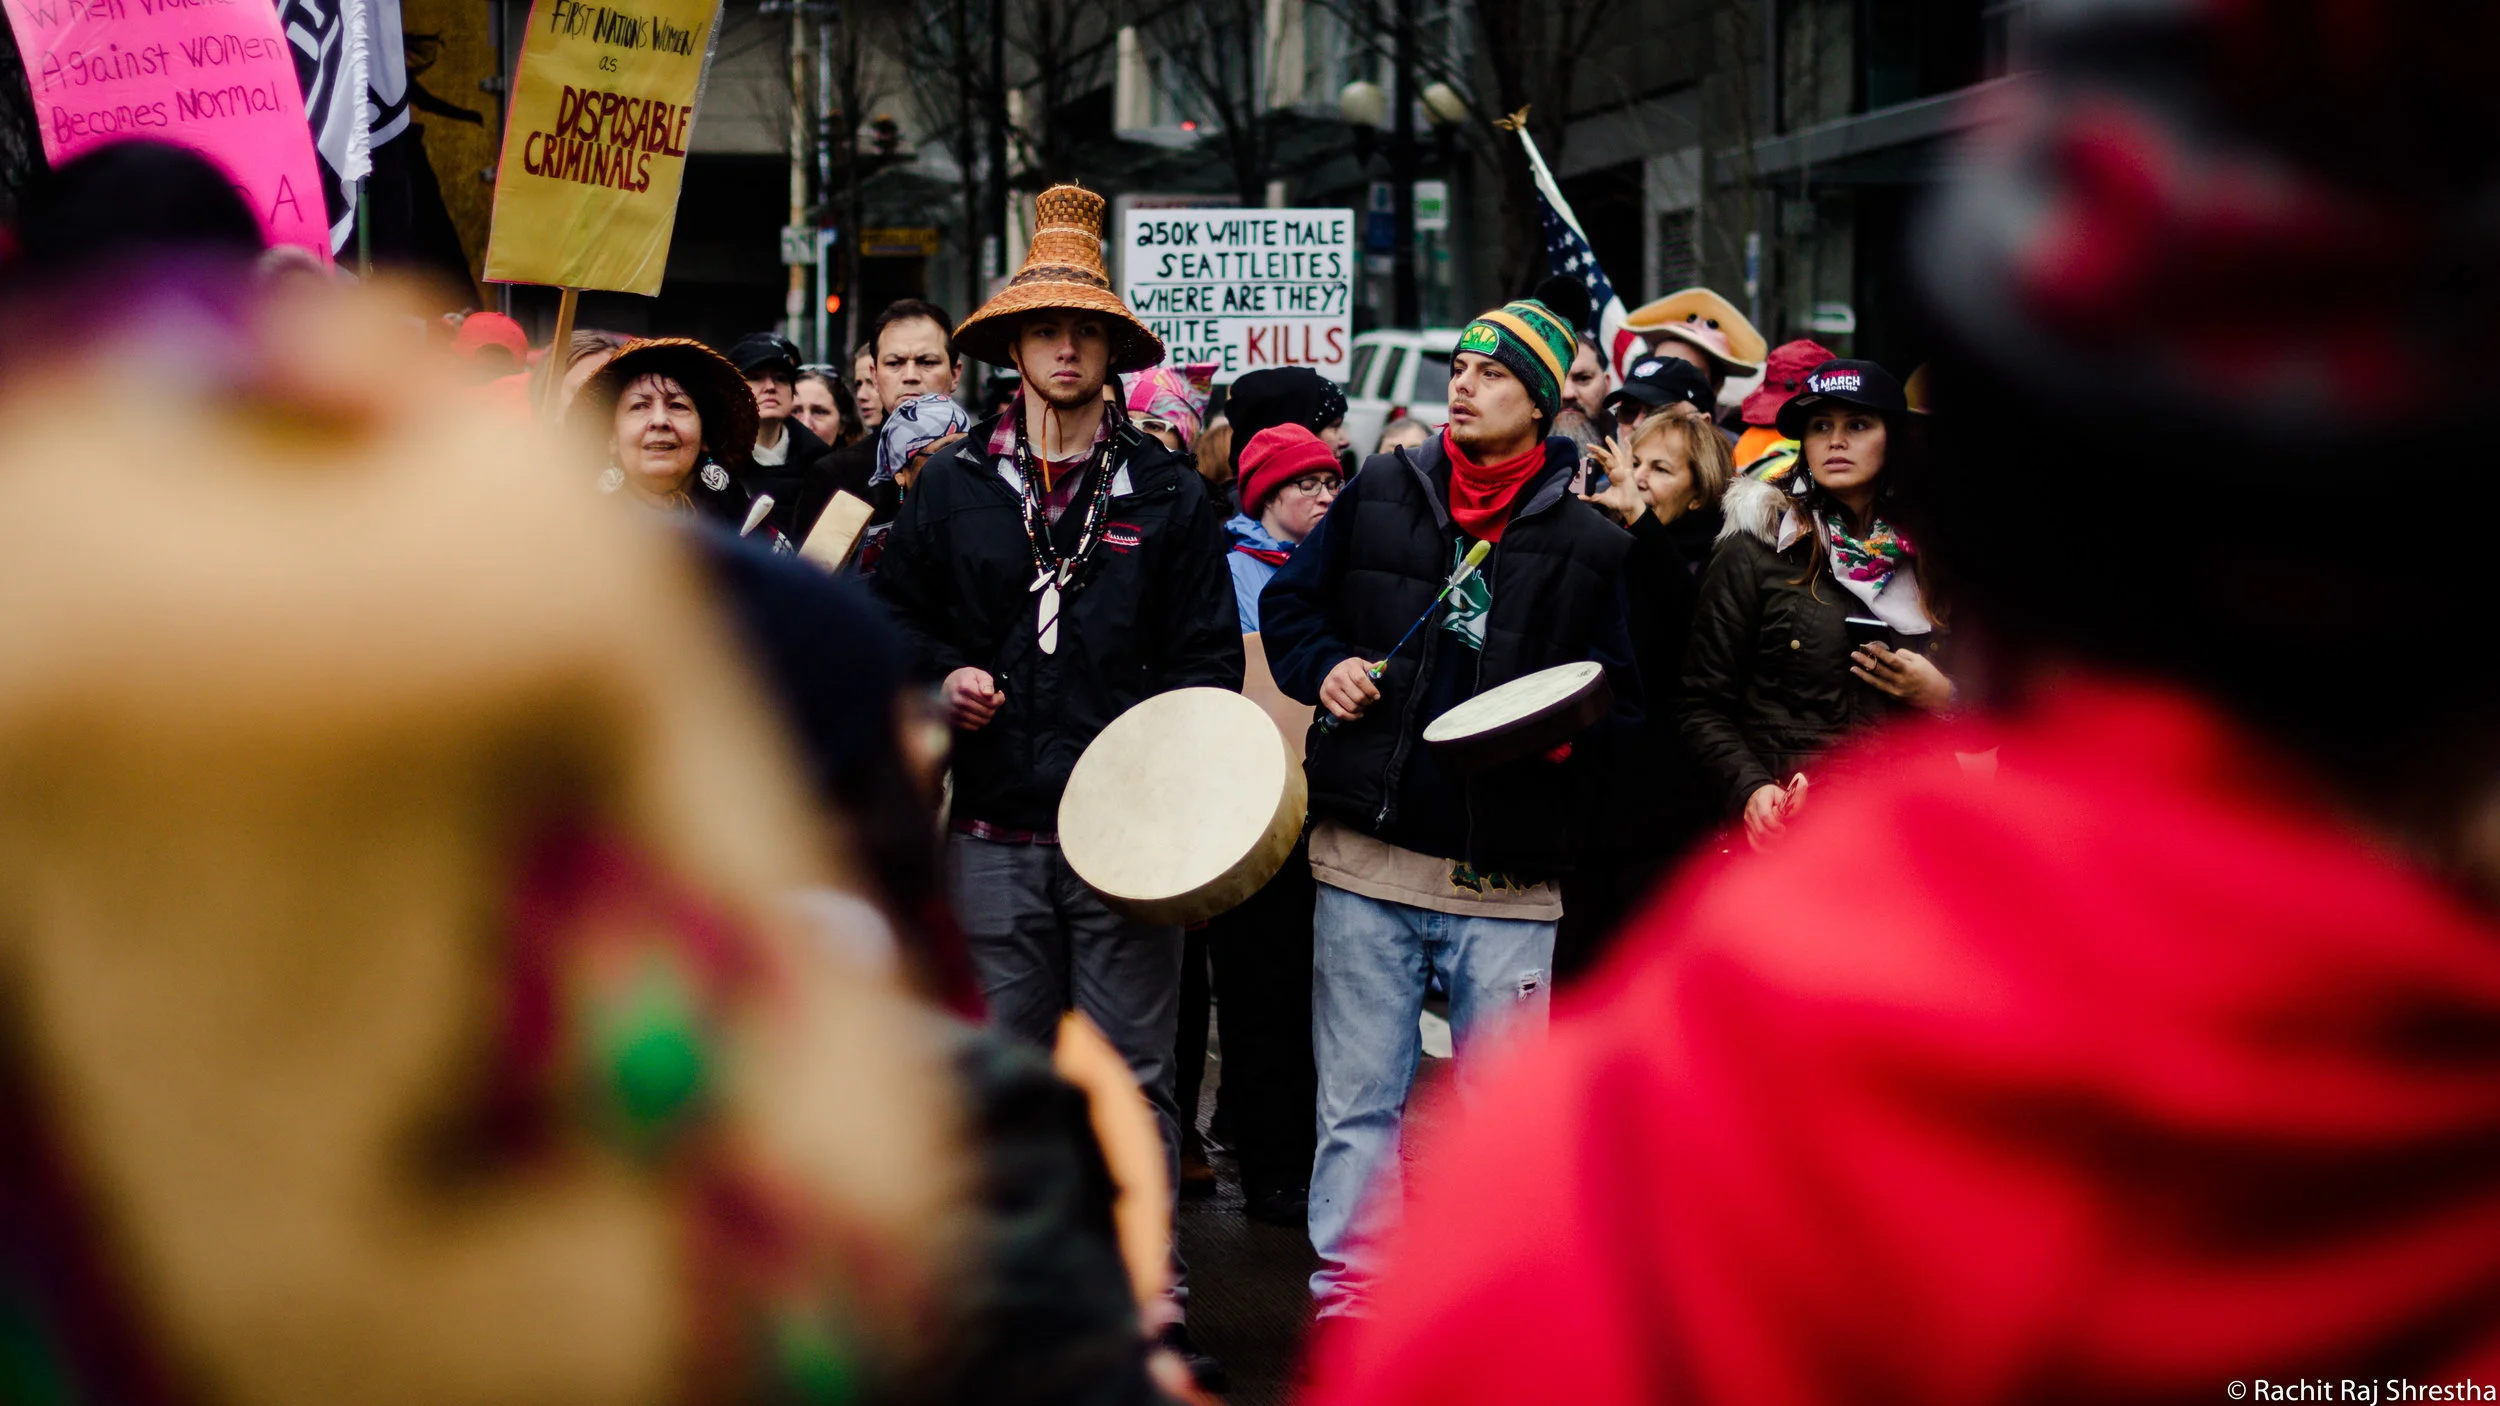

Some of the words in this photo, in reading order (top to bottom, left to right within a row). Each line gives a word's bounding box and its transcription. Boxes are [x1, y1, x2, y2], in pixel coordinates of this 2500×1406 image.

[551, 0, 595, 40] FIRST
[593, 7, 648, 49] NATIONS
[653, 16, 703, 56] WOMEN
[42, 44, 169, 92] Against
[599, 56, 618, 72] as
[53, 101, 168, 143] Becomes
[556, 85, 692, 157] DISPOSABLE
[524, 131, 651, 193] CRIMINALS
[1137, 222, 1199, 246] 250K
[1206, 220, 1278, 246] WHITE
[1285, 220, 1344, 246] MALE
[1157, 252, 1347, 279] SEATTLEITES.
[1130, 286, 1214, 312] WHERE
[1223, 286, 1266, 311] ARE
[1274, 283, 1348, 315] THEY?
[1247, 325, 1344, 365] KILLS
[1820, 376, 1860, 389] MARCH
